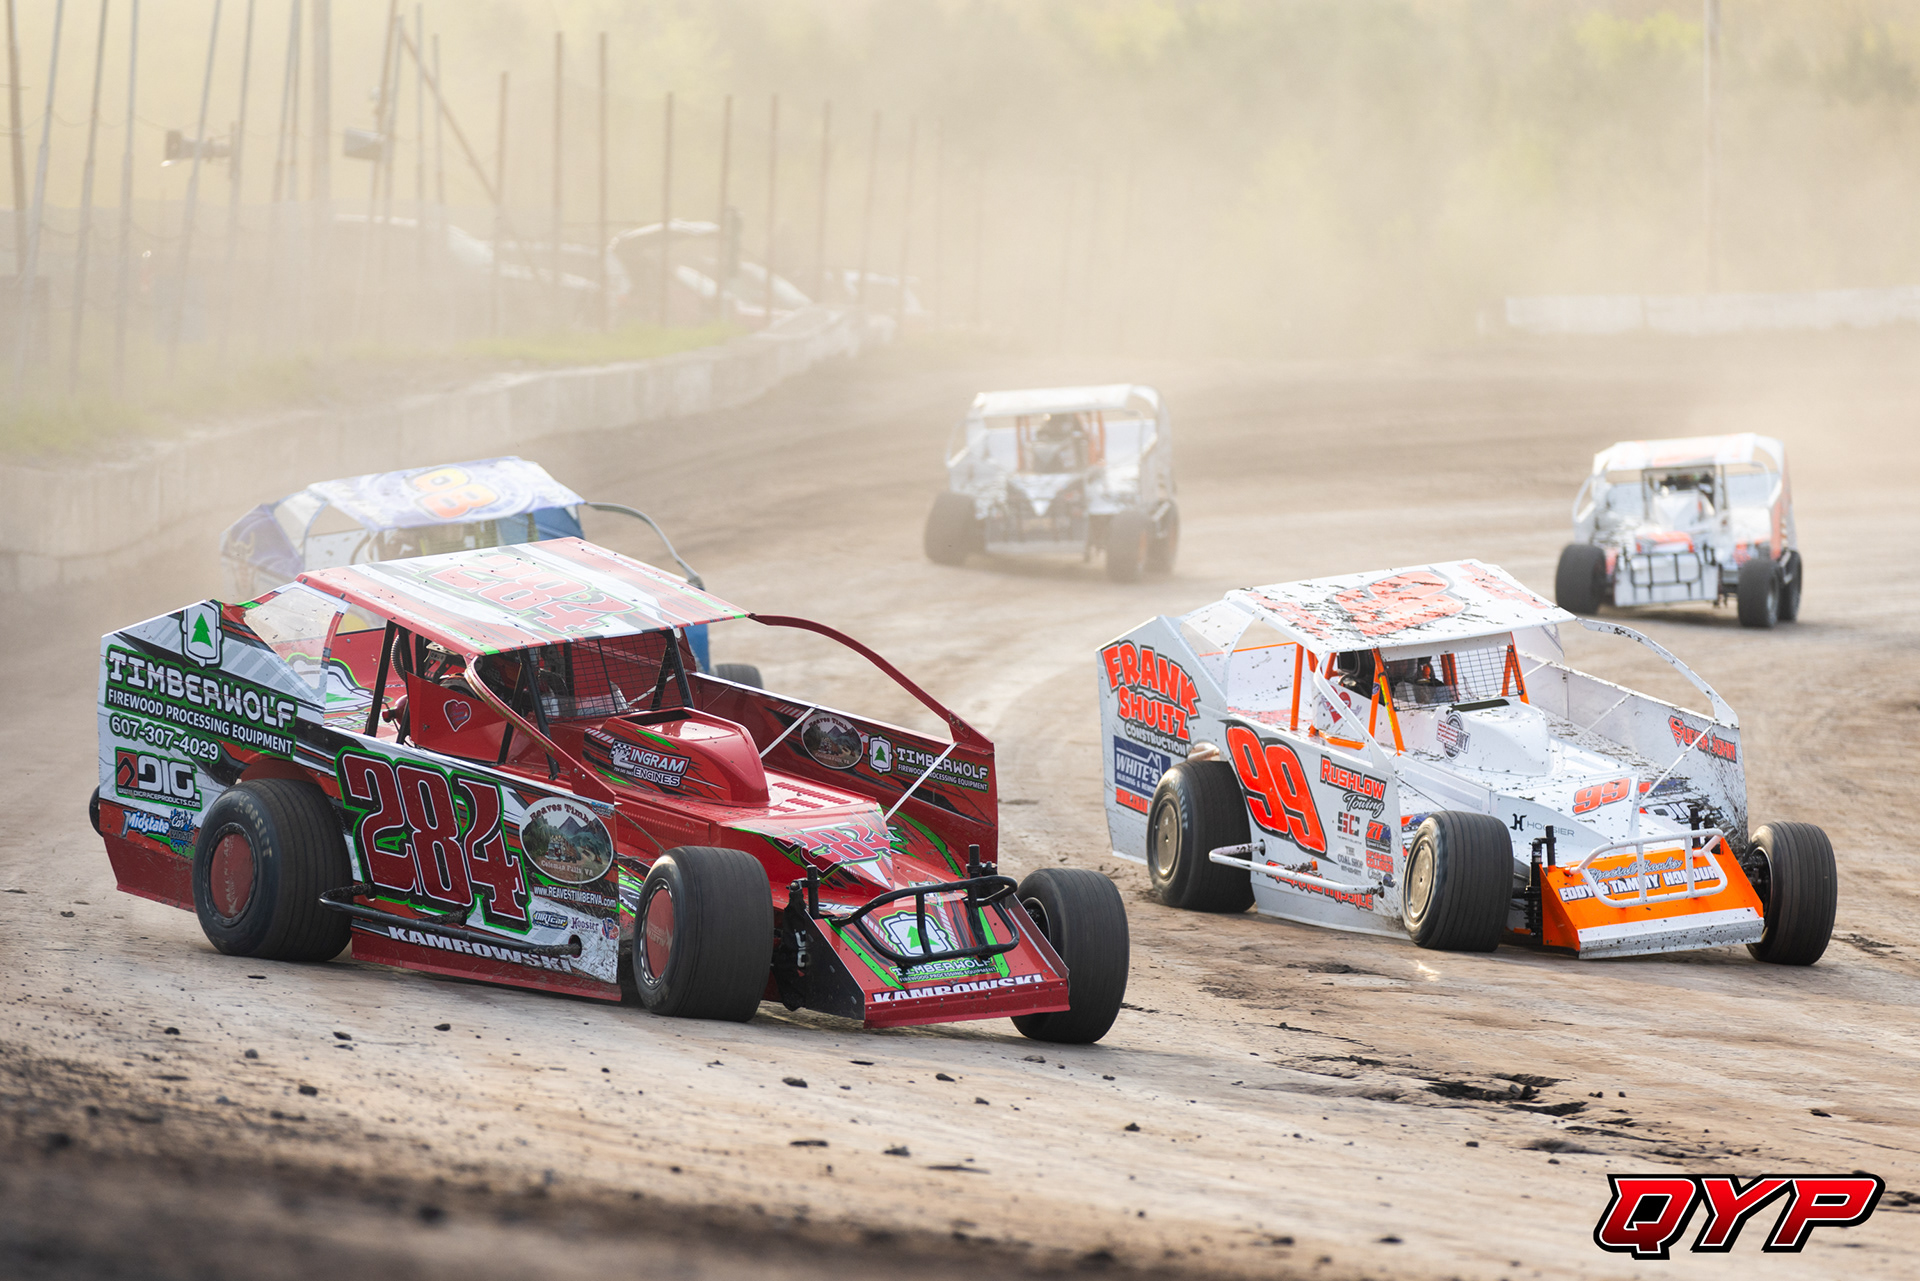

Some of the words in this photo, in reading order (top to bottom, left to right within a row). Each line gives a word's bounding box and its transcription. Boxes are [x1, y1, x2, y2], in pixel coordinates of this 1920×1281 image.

[108, 650, 295, 729] TIMBERWOLF
[1101, 642, 1199, 717] FRANK
[108, 689, 164, 717] FIREWOOD
[166, 704, 230, 736] PROCESSING
[231, 723, 293, 755] EQUIPMENT
[1118, 684, 1190, 741] SHULTZ
[111, 715, 220, 762] 607-307-4029
[1125, 722, 1188, 757] CONSTRUCTION
[1710, 734, 1737, 761] JOHN
[630, 748, 686, 774] INGRAM
[634, 766, 680, 786] ENGINES
[896, 746, 988, 779] TIMBERWOLF
[1115, 752, 1160, 786] WHITE'S
[927, 770, 957, 784] ROCESSING
[957, 777, 988, 791] EQUIPMENT
[1227, 726, 1327, 853] 99
[1573, 777, 1631, 815] 99
[122, 809, 171, 838] Midstate
[342, 753, 527, 921] 284
[1366, 821, 1384, 841] 71
[1526, 820, 1575, 837] HOSIER
[1559, 883, 1597, 902] EDDY
[387, 925, 574, 973] KAMROWSKI
